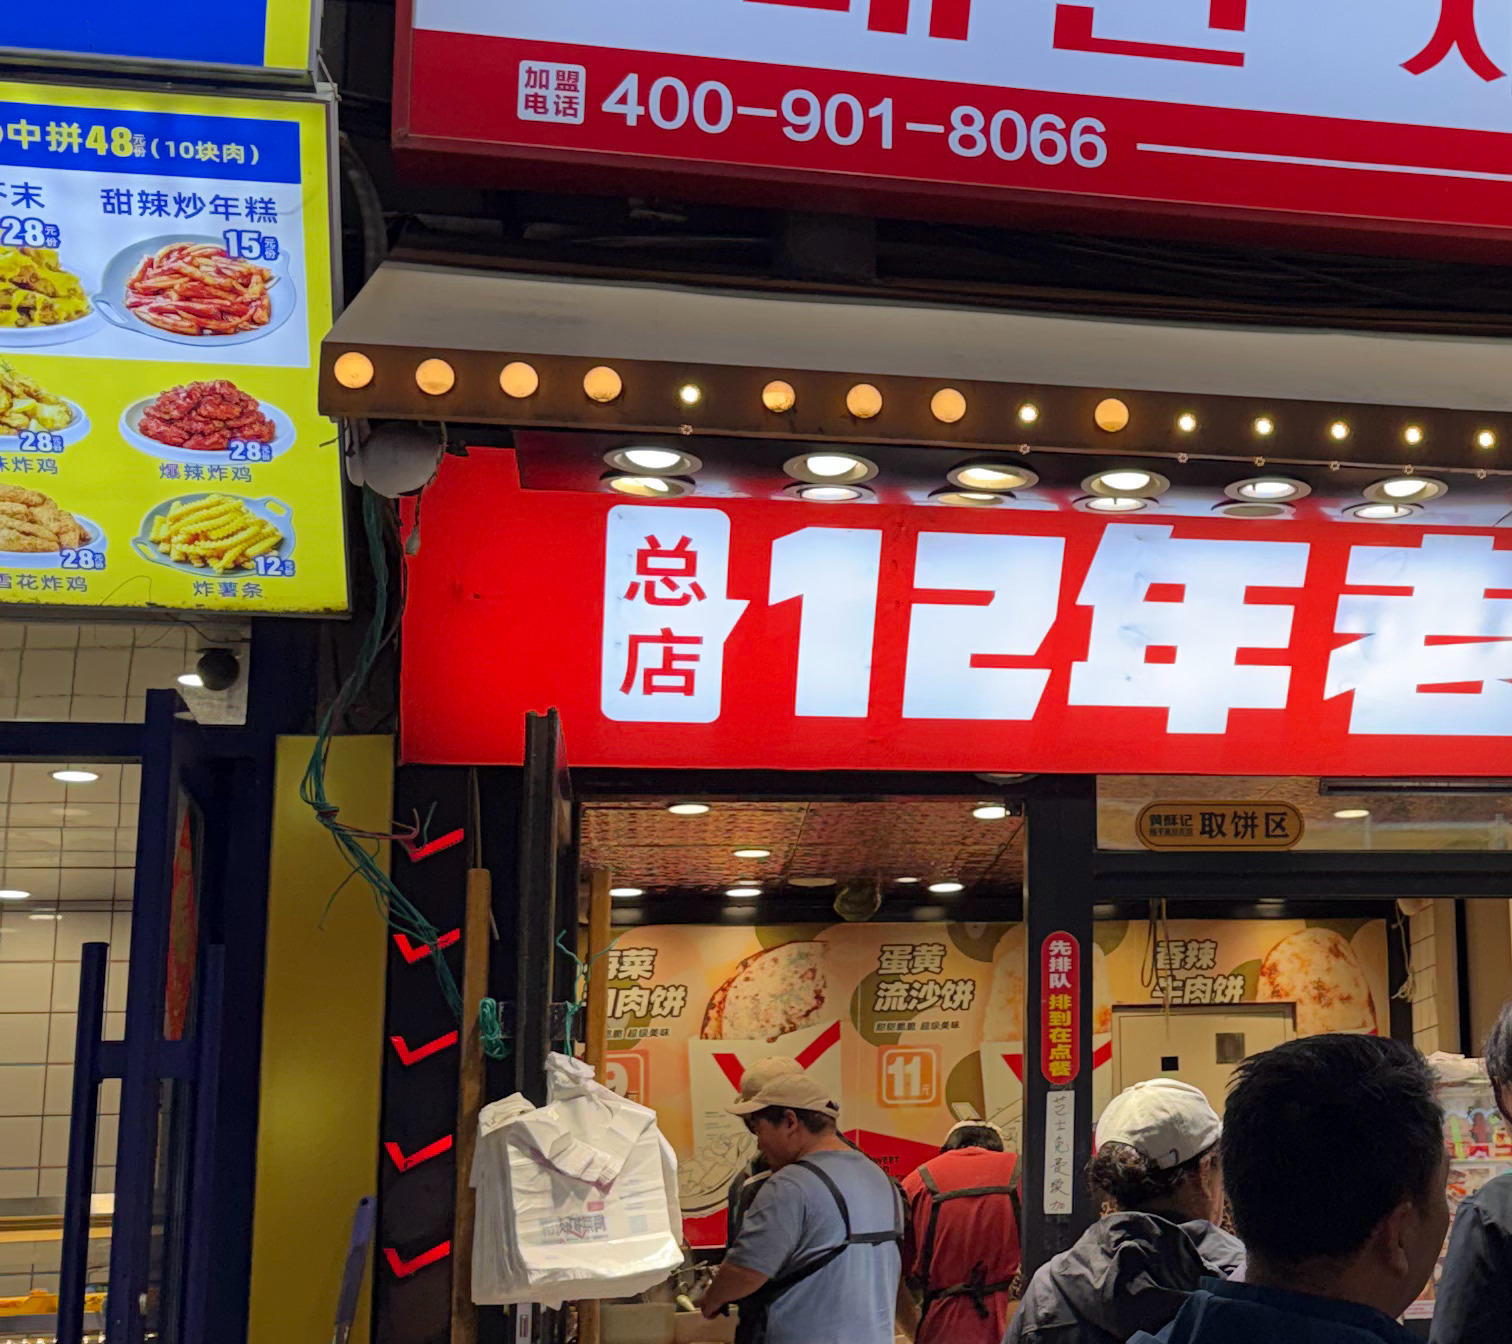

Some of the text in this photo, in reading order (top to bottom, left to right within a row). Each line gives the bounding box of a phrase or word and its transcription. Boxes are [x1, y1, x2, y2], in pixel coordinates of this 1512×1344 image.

[523, 65, 581, 94] 加盟
[523, 93, 581, 121] 电话
[601, 72, 1109, 169] 400-901-8066
[0, 181, 279, 224] 末 甜辣炒年糕
[0, 456, 252, 483] 炸鸡 爆辣炸鸡
[193, 581, 263, 599] 炸薯条
[619, 532, 708, 698] 总店
[1199, 810, 1290, 840] 取饼区
[877, 942, 947, 976] 蛋黄
[1156, 939, 1218, 970] 香辣
[607, 985, 688, 1019] 肉饼
[873, 979, 976, 1013] 流沙饼
[1048, 939, 1073, 1078] 先排队 排到在点餐
[887, 1056, 922, 1096] 11
